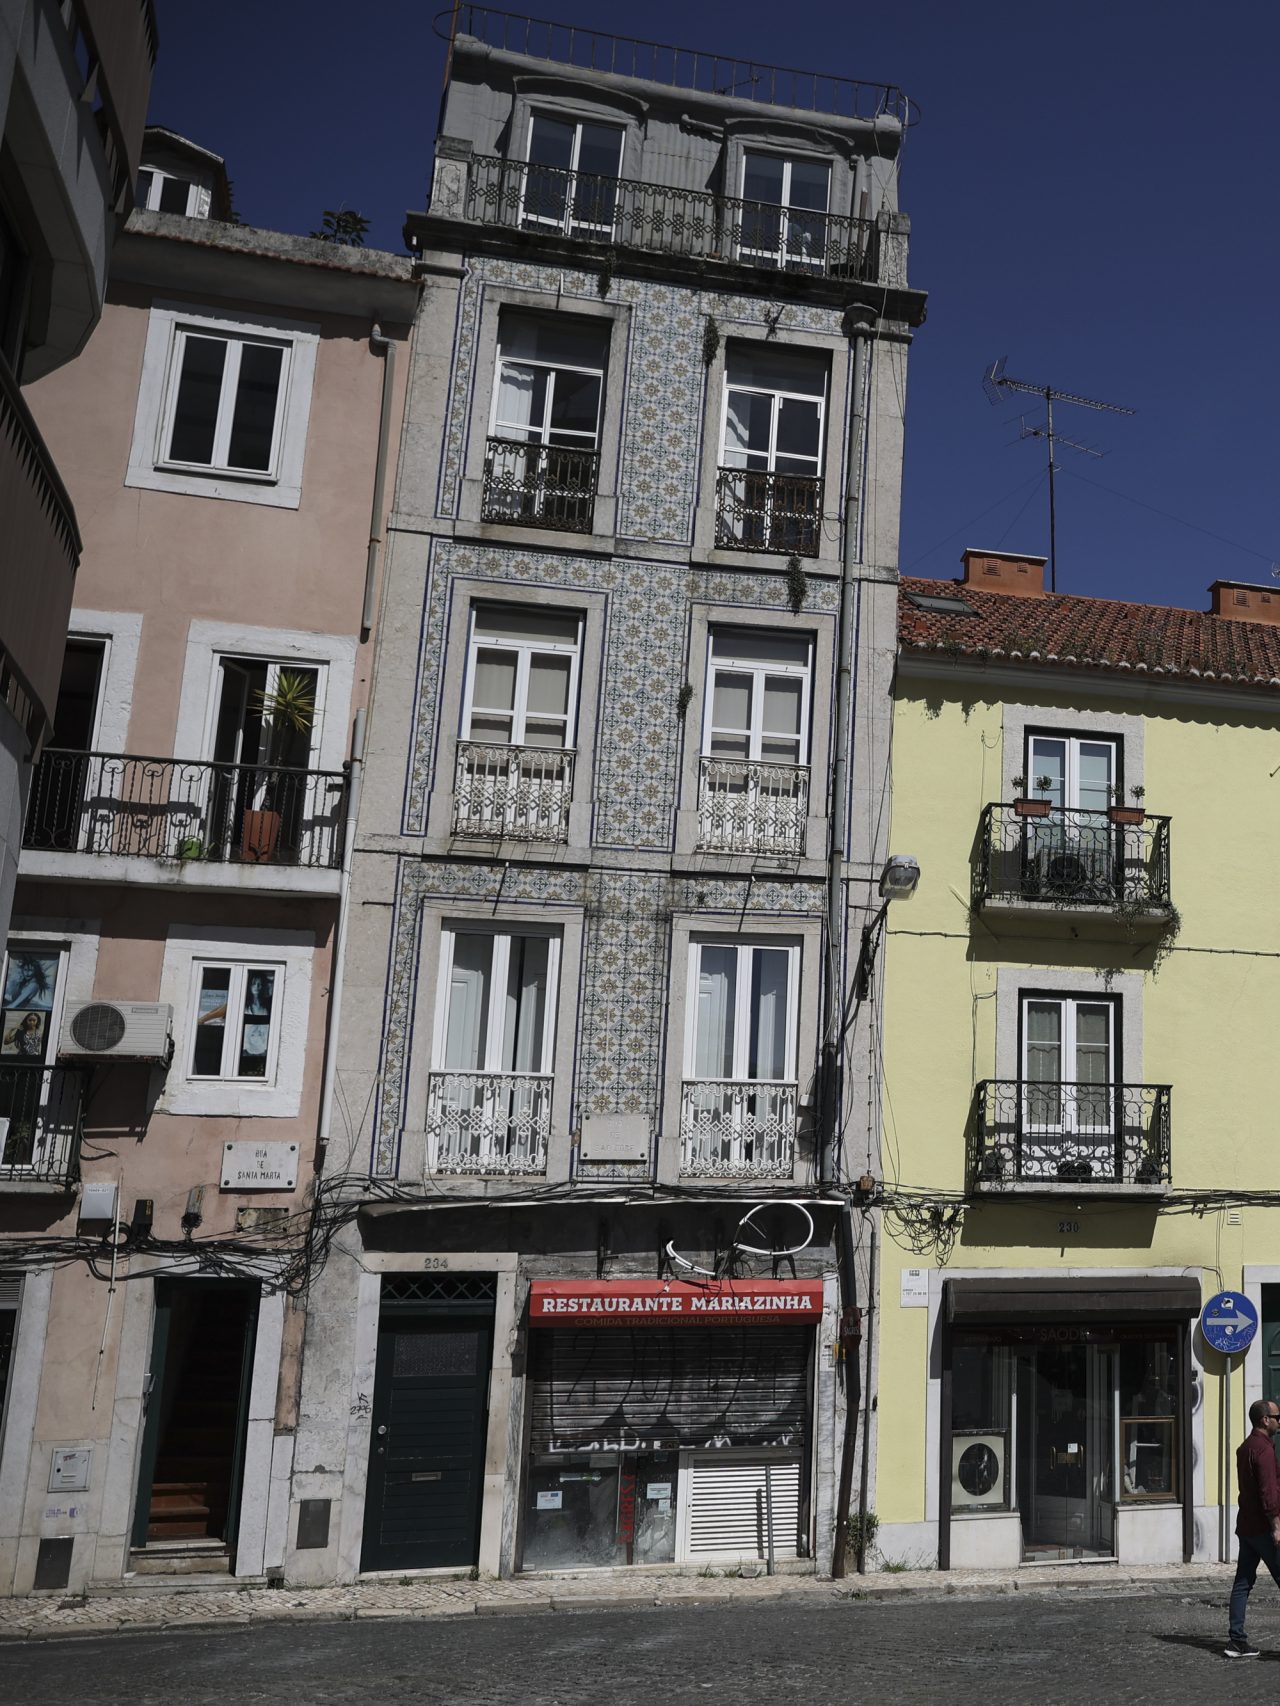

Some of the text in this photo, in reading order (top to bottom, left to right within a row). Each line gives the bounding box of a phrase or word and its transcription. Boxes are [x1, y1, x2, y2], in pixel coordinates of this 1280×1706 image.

[237, 1171, 281, 1180] SANTA MARTA
[1058, 1222, 1079, 1233] 230
[424, 1257, 449, 1269] 234
[542, 1295, 813, 1312] RESTAURANTE MARIAZINHA
[574, 1315, 781, 1327] COMIDA TRADICIONAL PORTUGUESA
